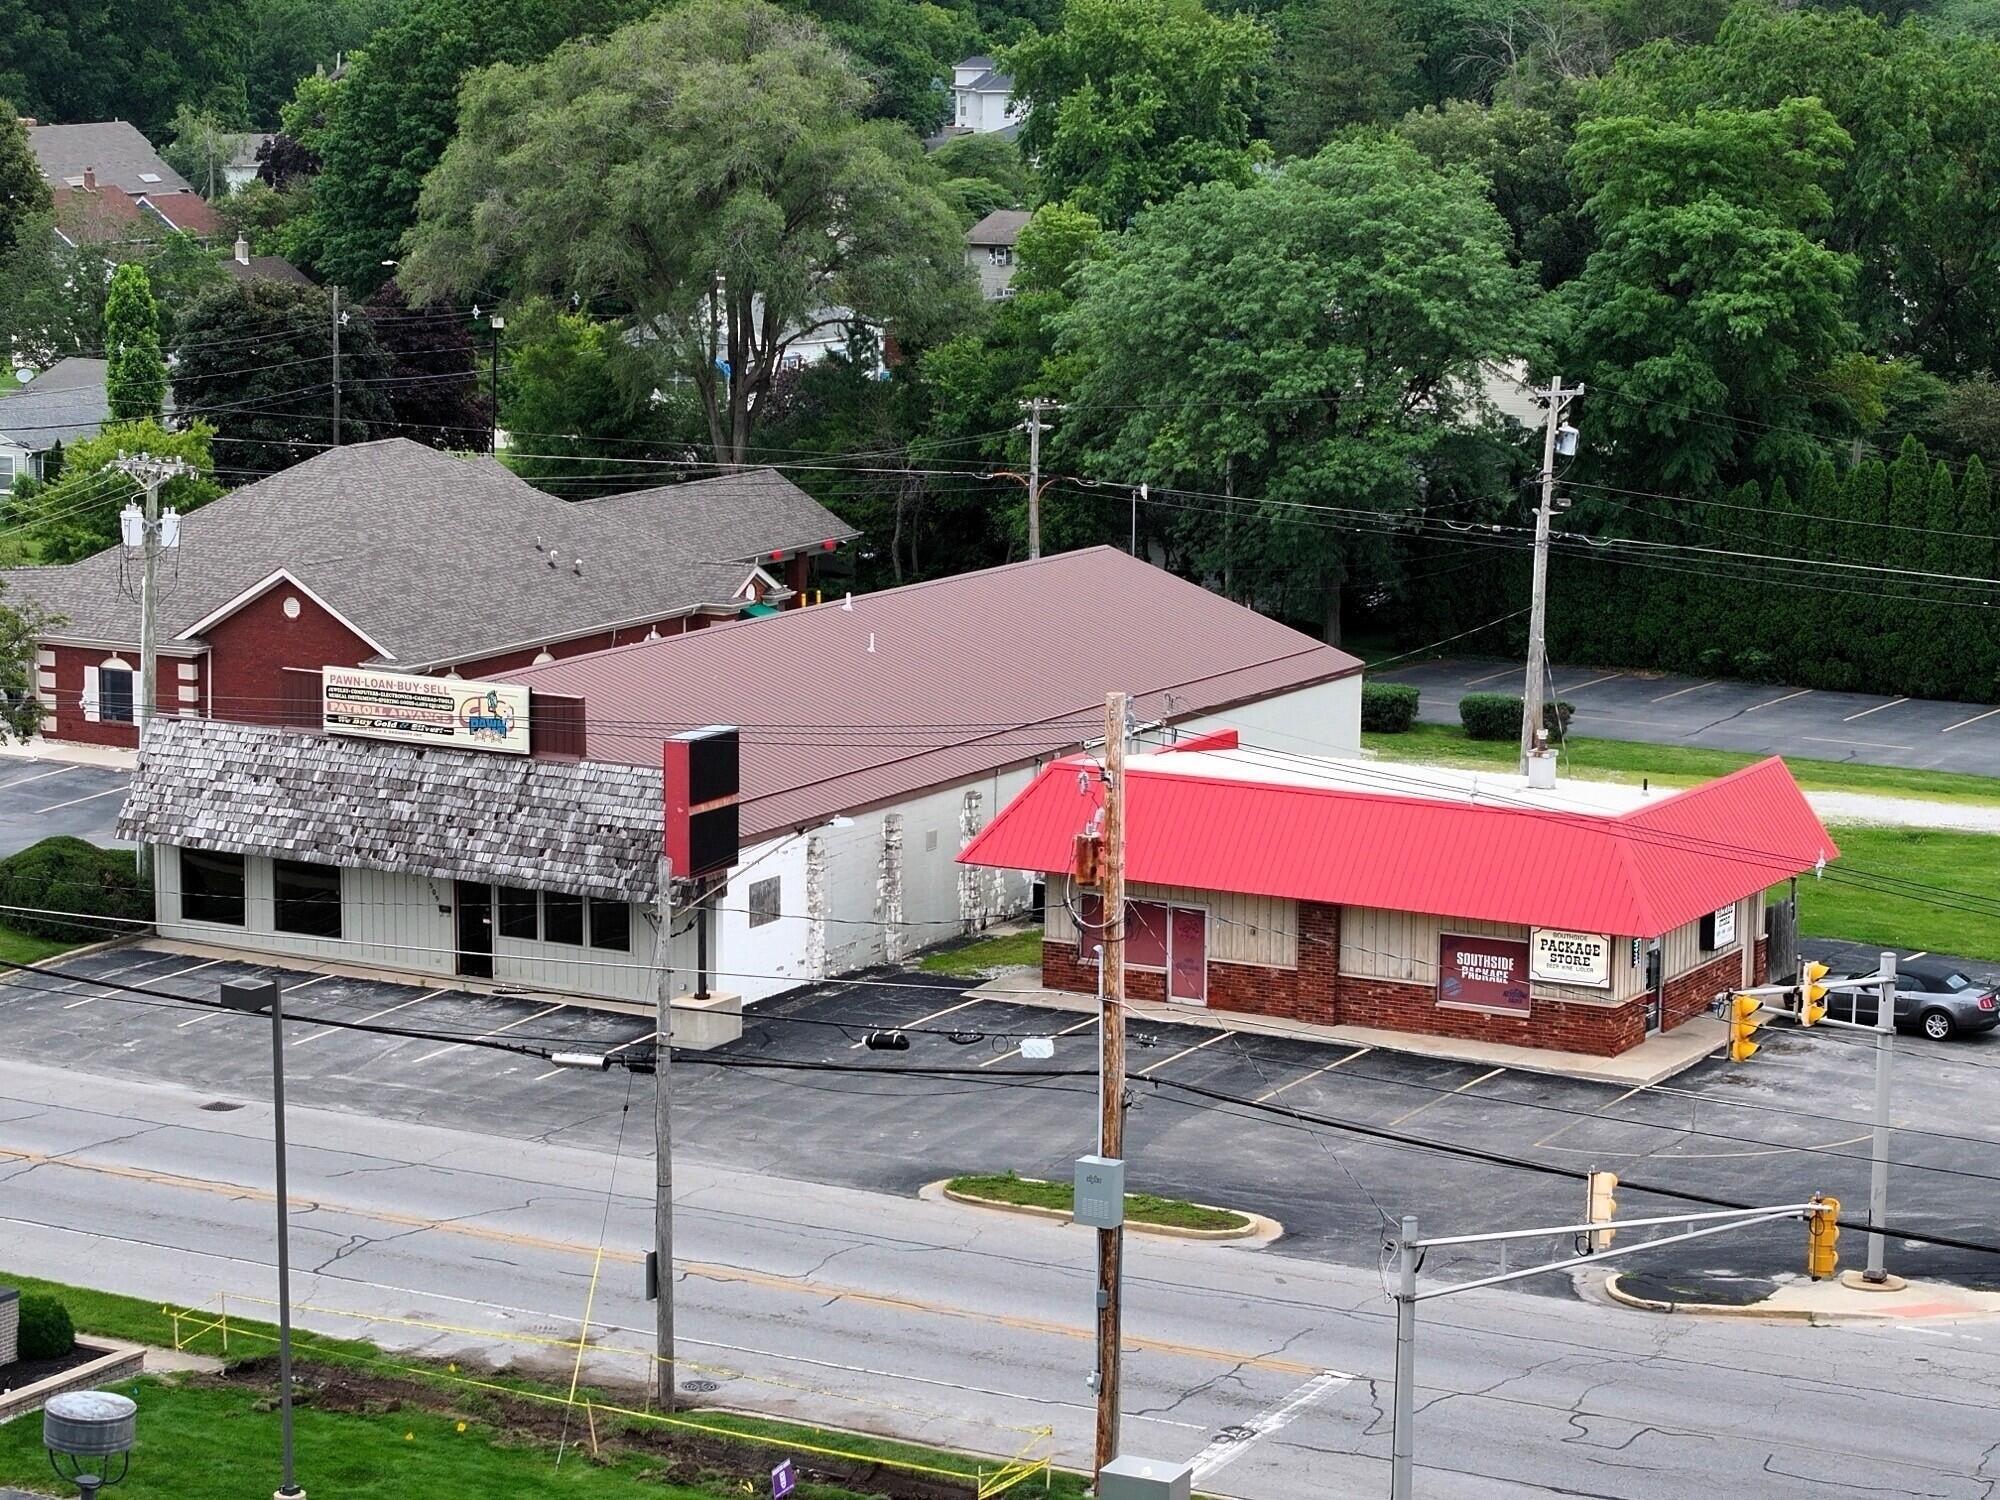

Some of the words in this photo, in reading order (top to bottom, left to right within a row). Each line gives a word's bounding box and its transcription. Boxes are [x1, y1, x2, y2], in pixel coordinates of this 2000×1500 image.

[329, 674, 450, 695] PAWN-LOAN-BUY-SELL
[330, 702, 386, 716] PAYROLL
[388, 708, 450, 723] ADVANCE
[338, 716, 351, 724] We
[352, 717, 372, 727] Buy
[374, 719, 398, 728] Gold
[1553, 932, 1588, 942] SOUTHSIDE
[1540, 939, 1601, 957] PACKAGE
[1456, 951, 1515, 972] SOUTHSIDE
[1550, 953, 1591, 967] STORE
[1461, 966, 1509, 985] PACKAGE
